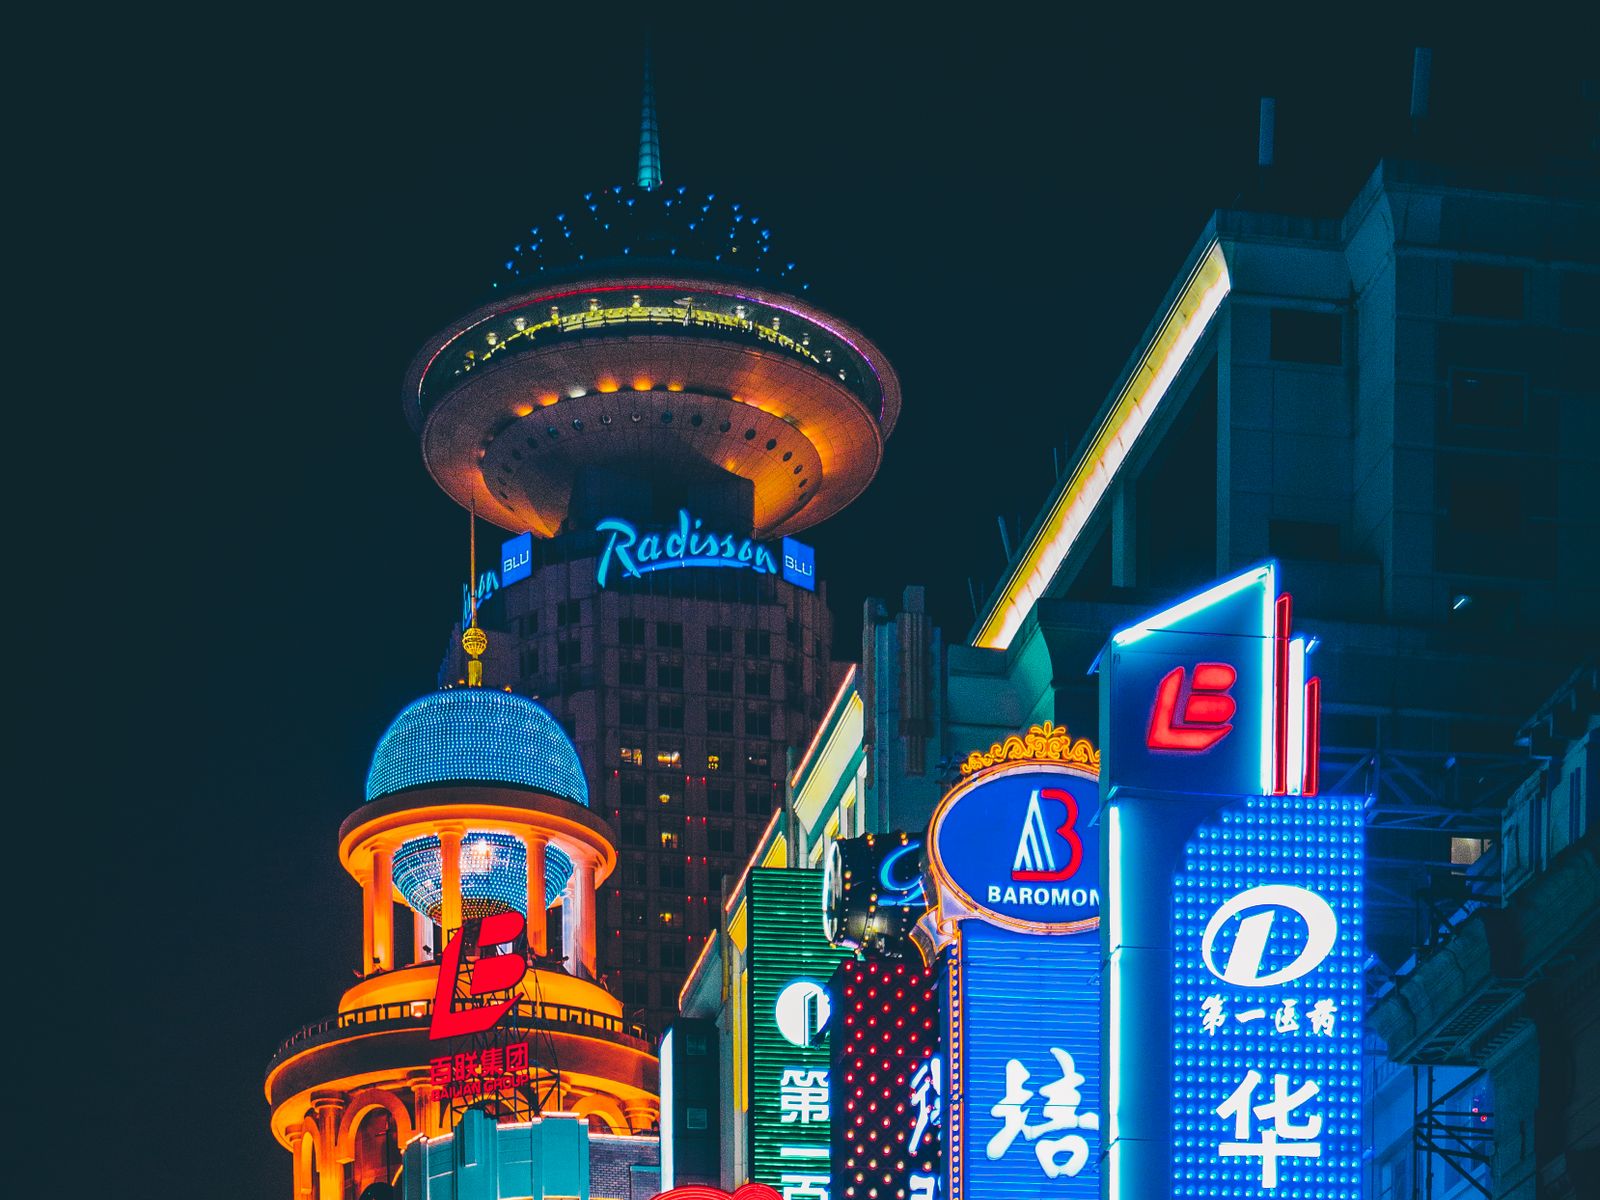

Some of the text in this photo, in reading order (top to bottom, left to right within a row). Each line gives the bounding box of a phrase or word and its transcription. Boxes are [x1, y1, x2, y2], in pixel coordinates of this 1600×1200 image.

[503, 547, 530, 573] BLU
[596, 509, 778, 587] Radisson
[785, 556, 812, 577] BLU
[988, 885, 1099, 907] BAROMON
[1201, 994, 1337, 1037] 第一医药
[430, 1042, 529, 1086] 百联集团
[483, 1073, 530, 1093] GROUP
